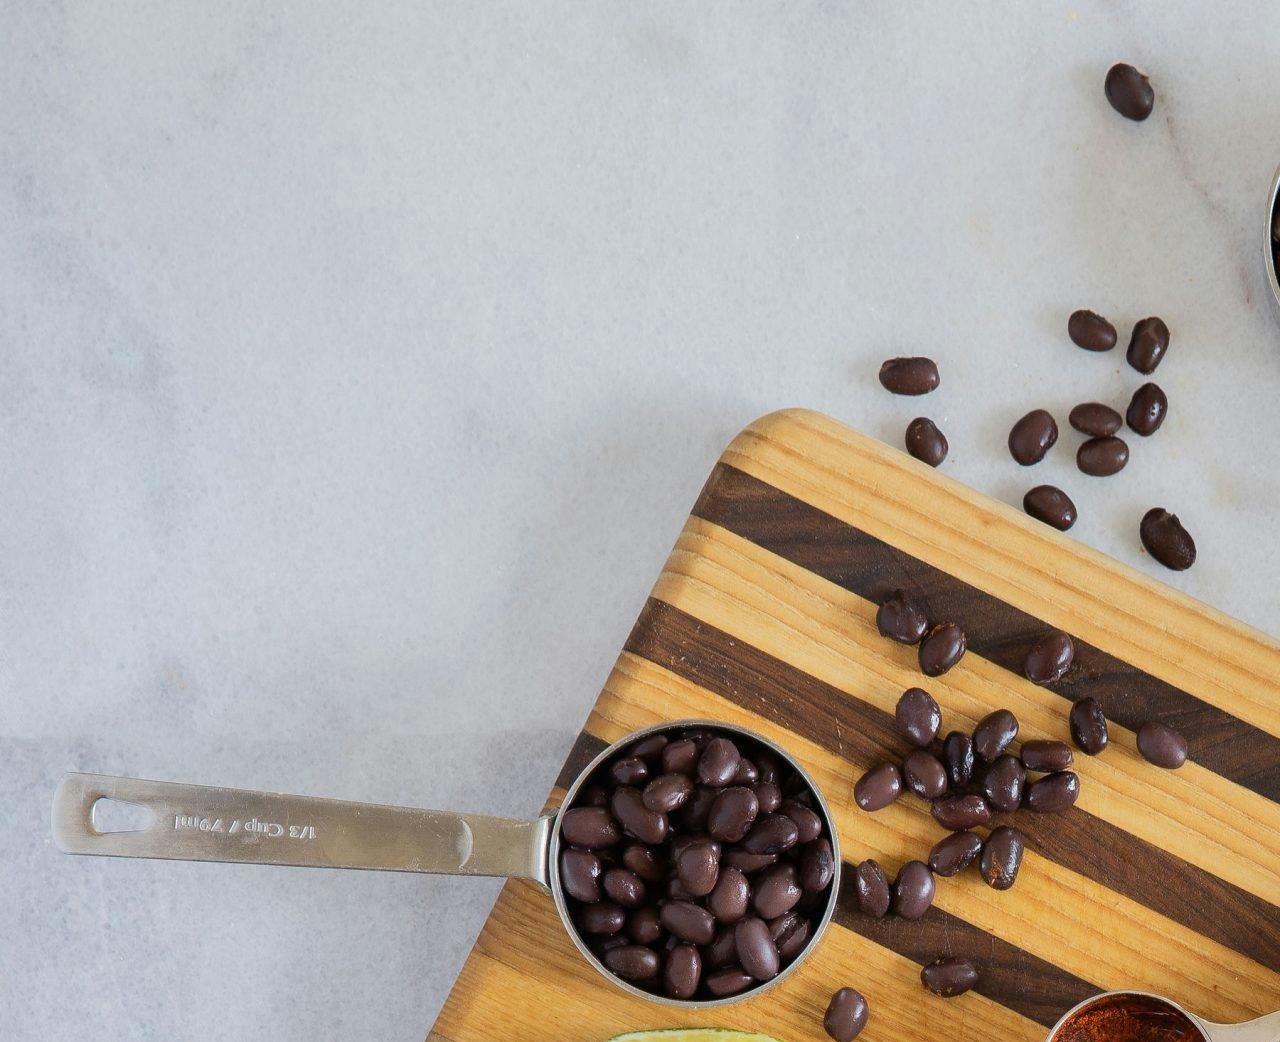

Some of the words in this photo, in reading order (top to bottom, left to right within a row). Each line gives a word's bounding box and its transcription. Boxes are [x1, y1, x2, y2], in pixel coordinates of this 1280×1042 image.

[173, 815, 224, 832] 79ml
[243, 817, 285, 837] Cup
[288, 824, 317, 840] 1/3
